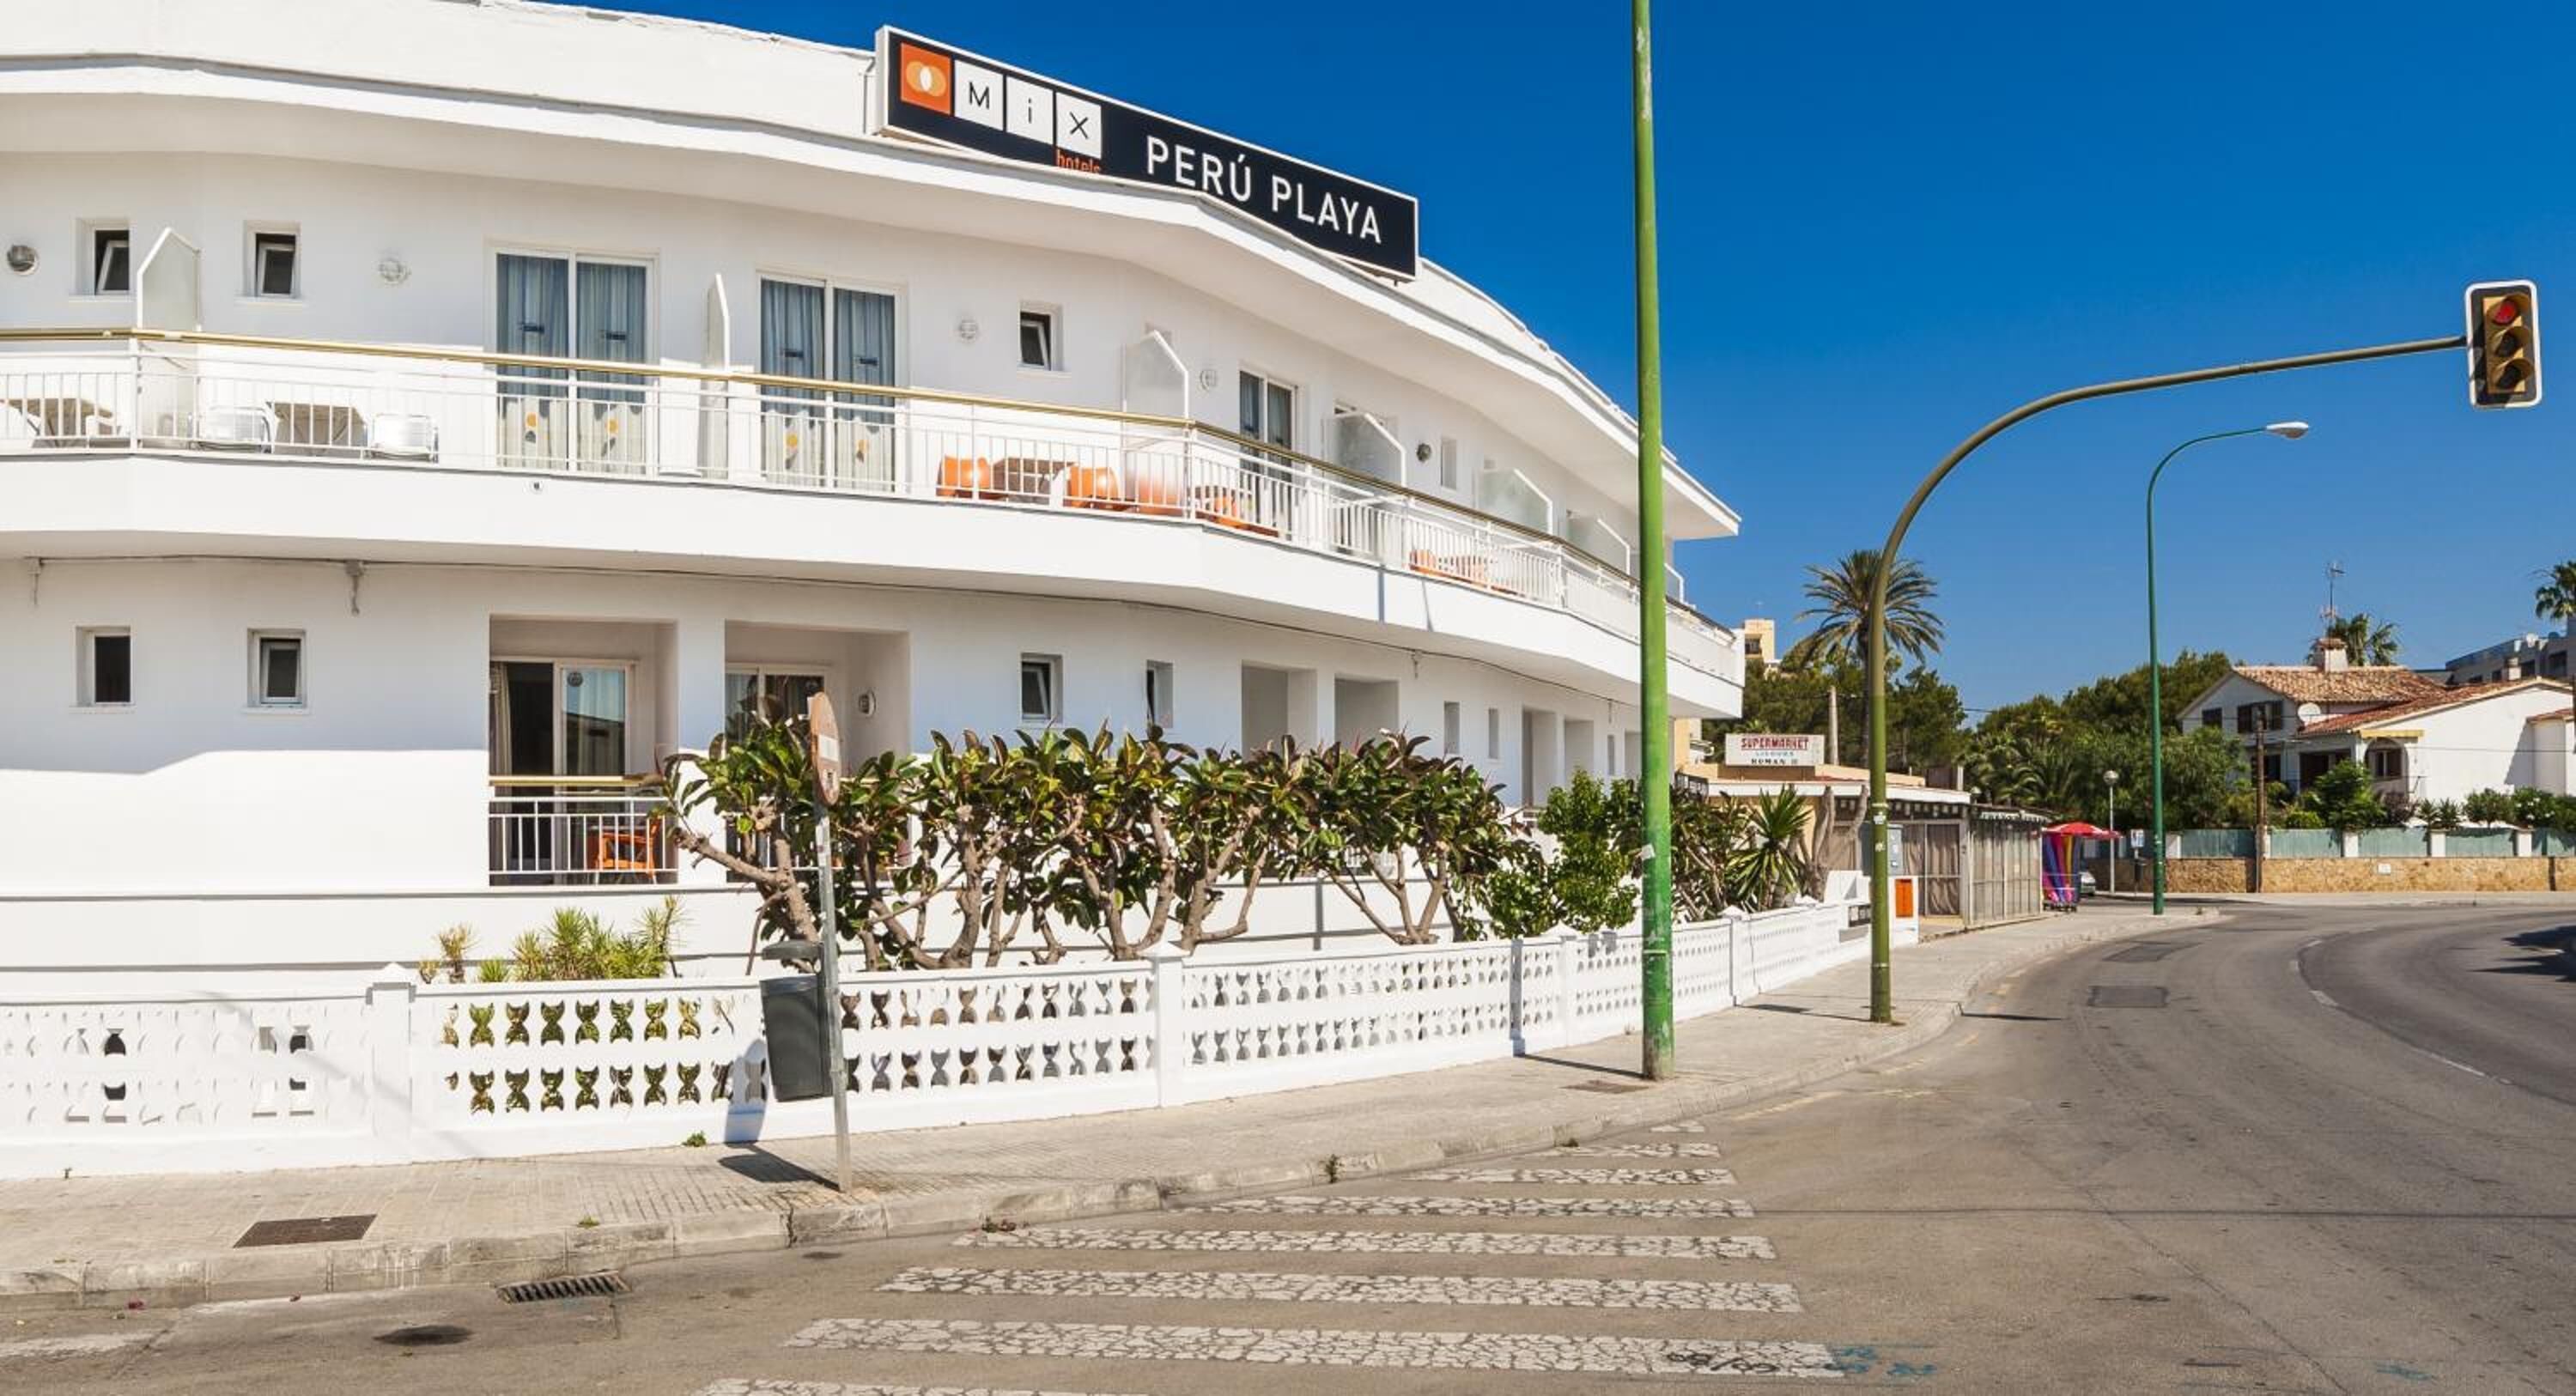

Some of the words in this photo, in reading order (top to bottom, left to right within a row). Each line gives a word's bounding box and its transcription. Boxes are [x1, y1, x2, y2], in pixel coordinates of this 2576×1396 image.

[1146, 135, 1252, 203] PERÚ
[1272, 174, 1382, 245] PLAYA
[1741, 737, 1809, 749] SUPERMARKET
